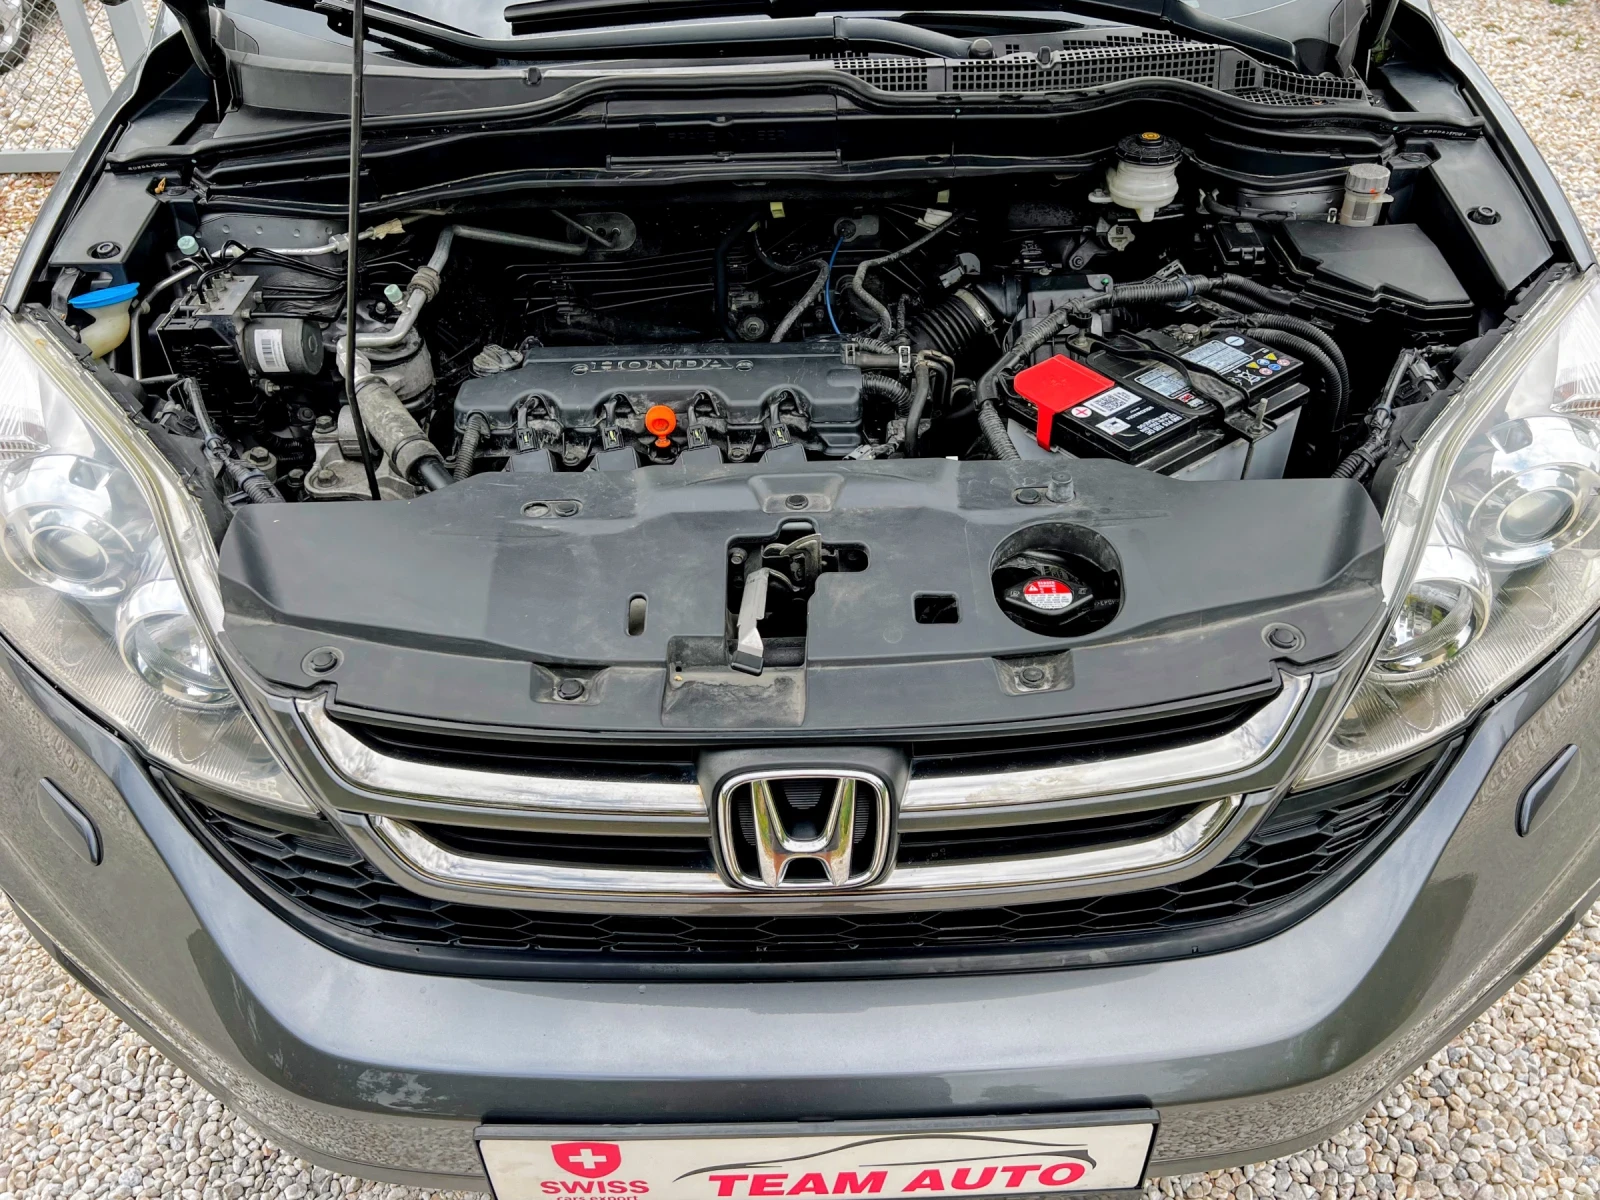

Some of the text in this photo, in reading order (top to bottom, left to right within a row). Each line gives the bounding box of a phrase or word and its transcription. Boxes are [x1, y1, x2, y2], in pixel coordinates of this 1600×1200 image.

[590, 359, 734, 373] HONDA
[540, 1180, 650, 1195] SWISS
[708, 1163, 1086, 1197] TEAM AUTO
